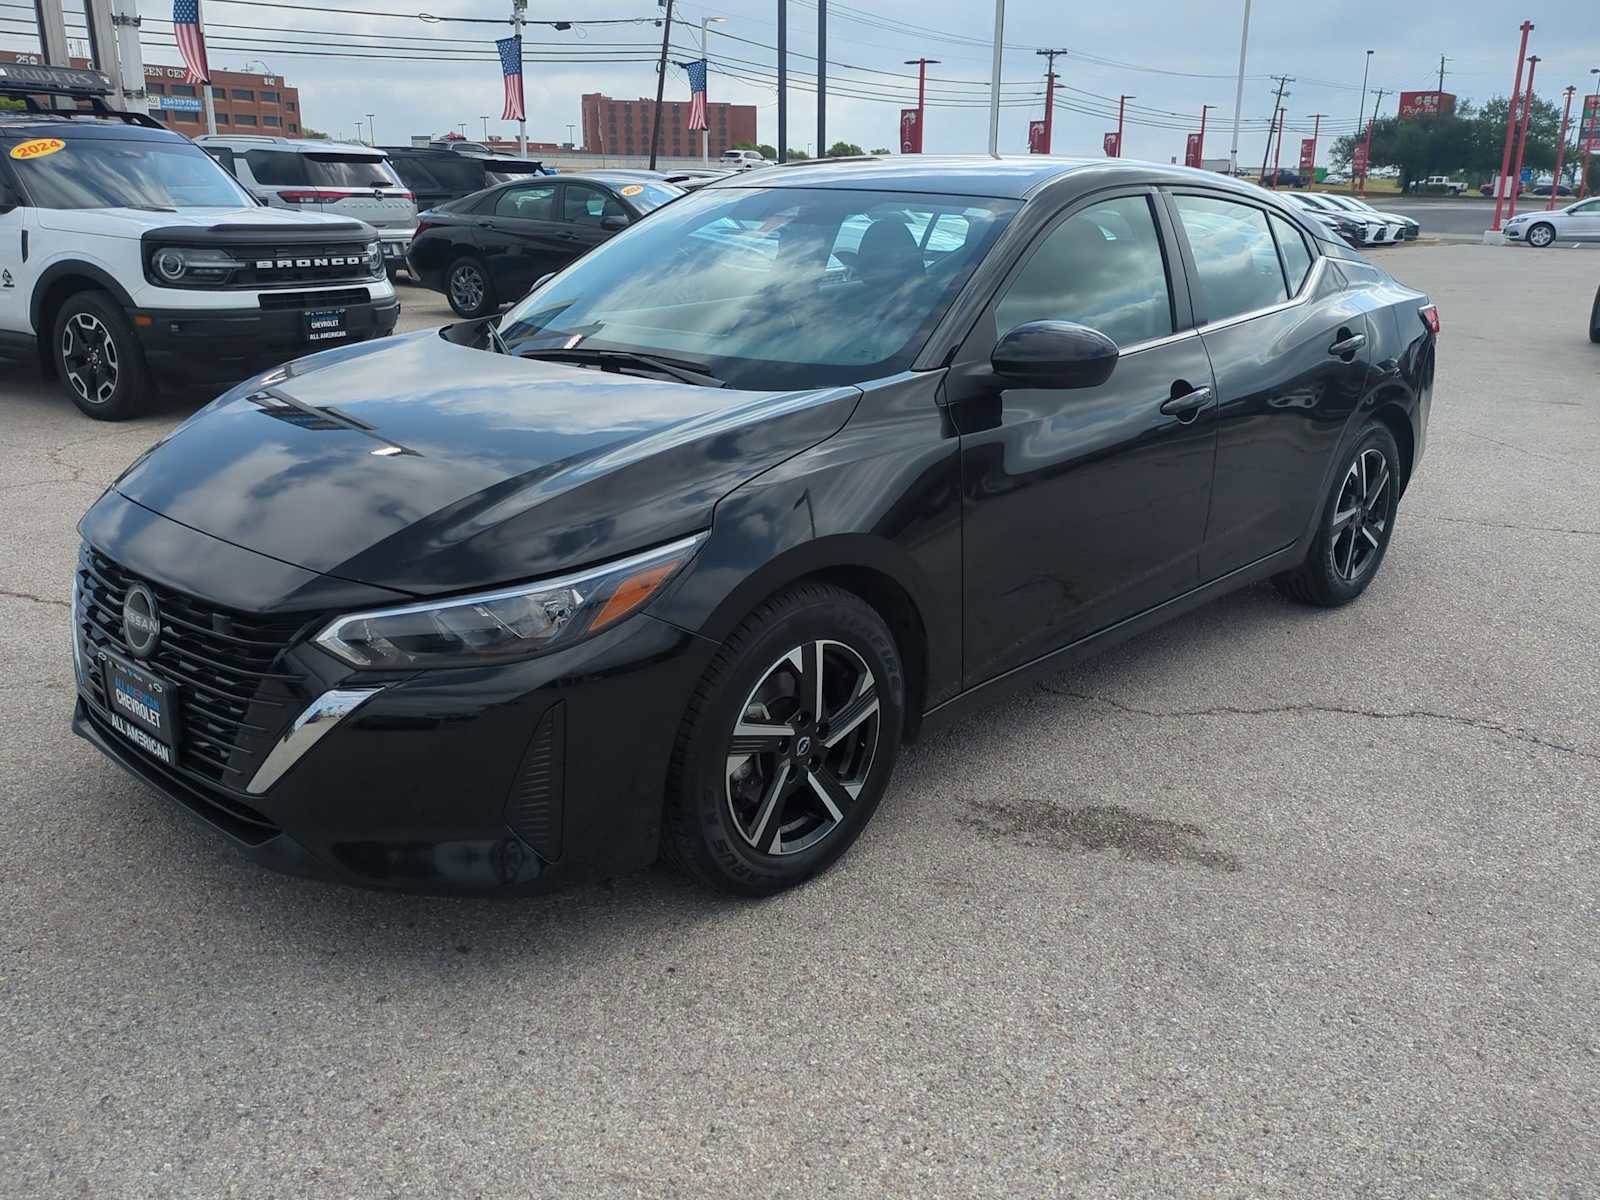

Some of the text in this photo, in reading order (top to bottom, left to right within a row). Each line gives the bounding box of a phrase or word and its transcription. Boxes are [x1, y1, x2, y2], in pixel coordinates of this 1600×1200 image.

[17, 140, 62, 158] 2024
[255, 257, 360, 269] BRONCO
[311, 319, 339, 329] CHEVROLET
[309, 330, 347, 341] ALL AMERICAN
[115, 688, 160, 728] CHEVROLET
[111, 713, 170, 763] ALL AMERICAN
